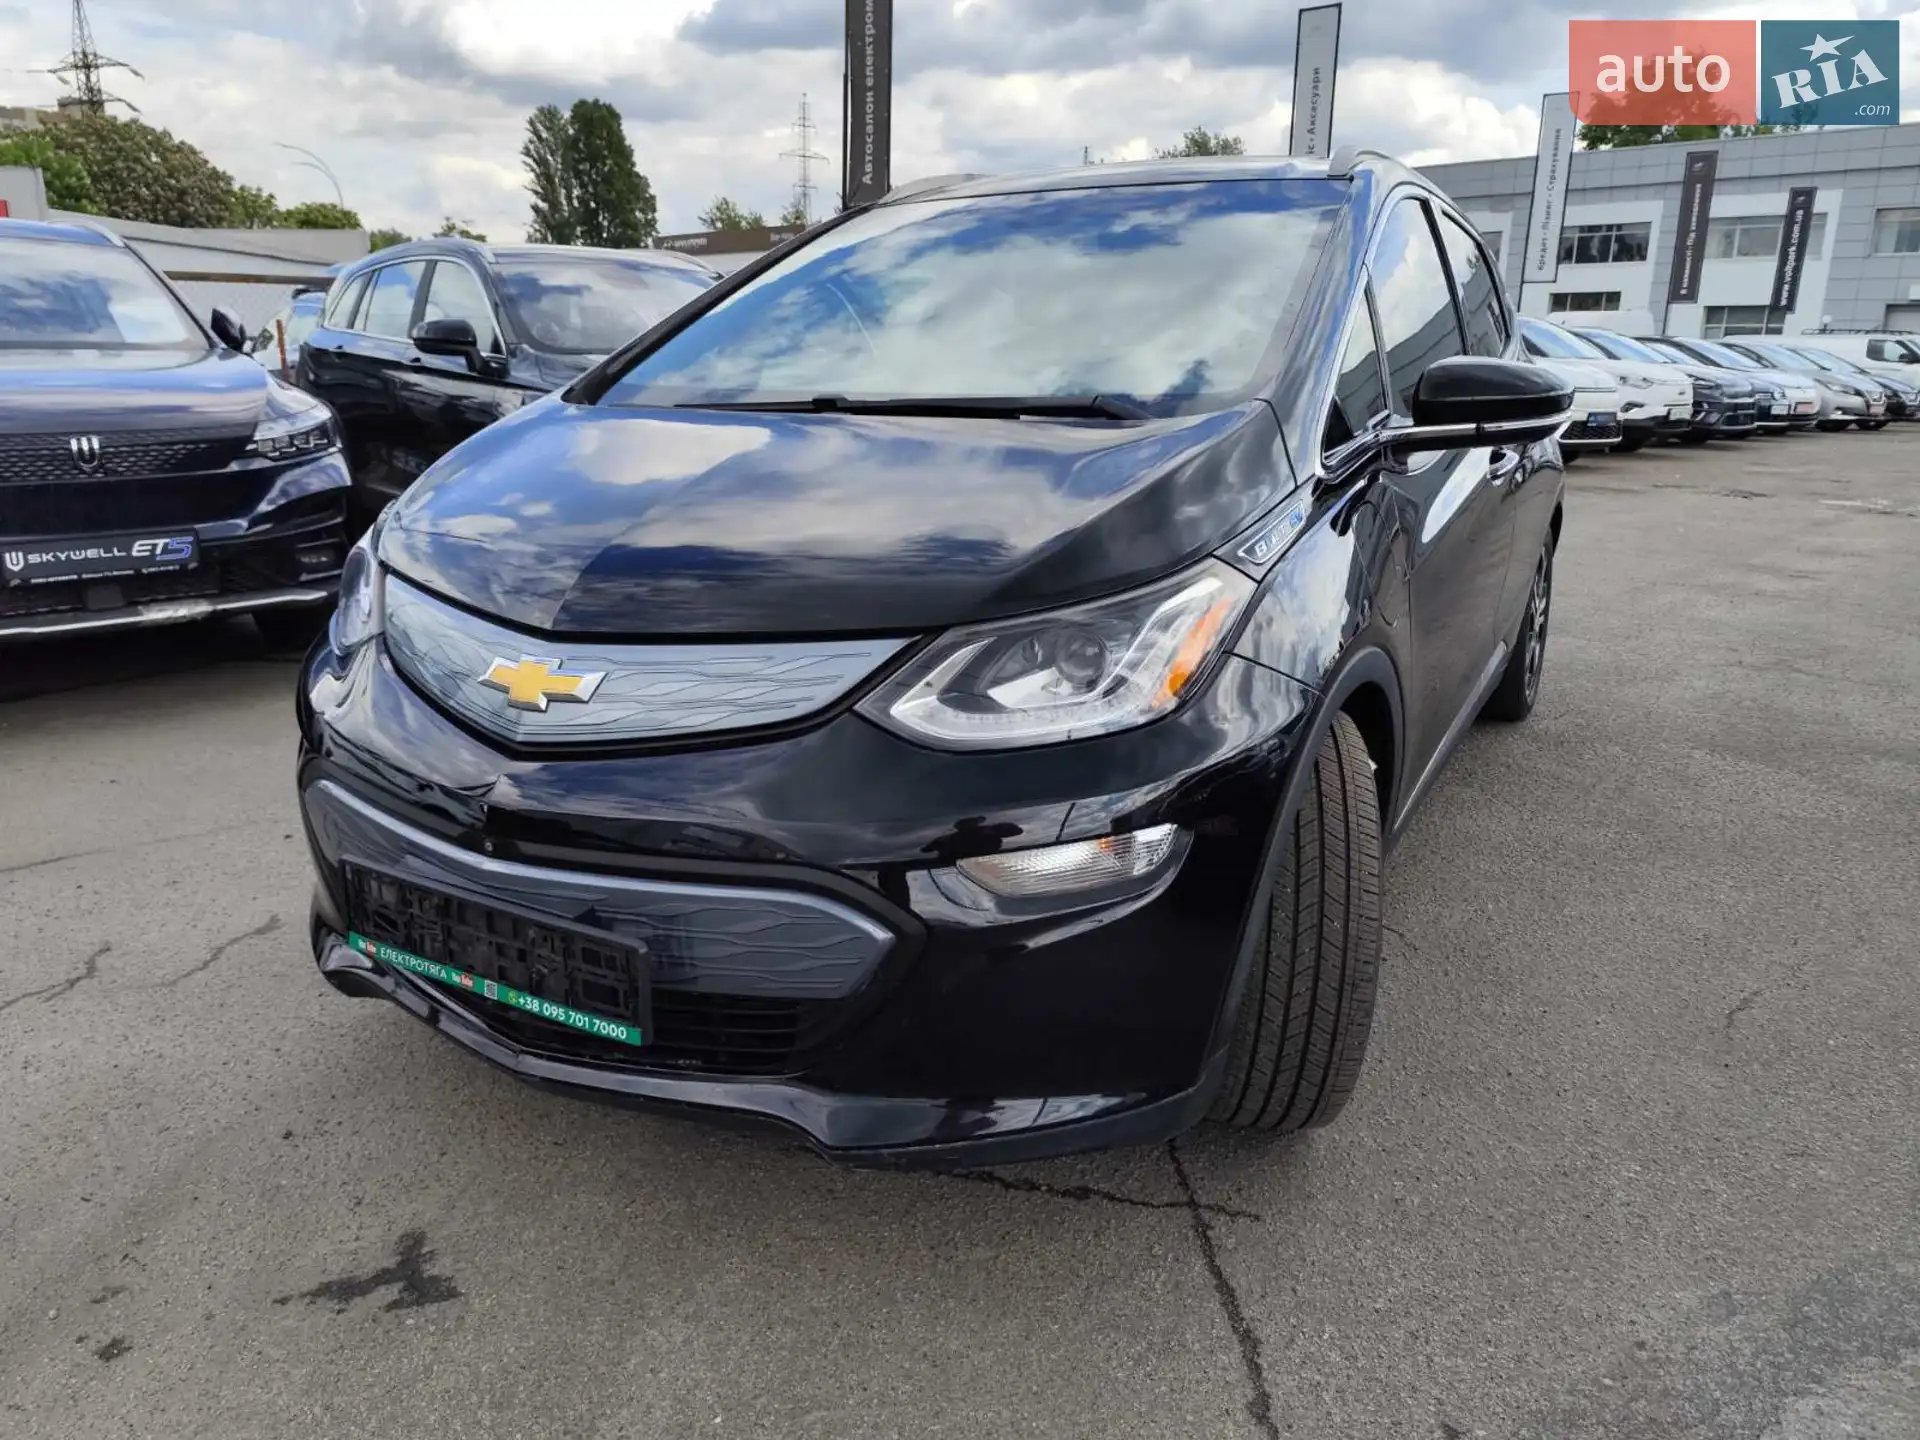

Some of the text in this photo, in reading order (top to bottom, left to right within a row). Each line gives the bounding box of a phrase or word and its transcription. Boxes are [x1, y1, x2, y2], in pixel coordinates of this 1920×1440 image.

[1307, 67, 1321, 134] Аксесуари
[862, 91, 875, 184] Автосалон
[27, 536, 194, 564] SKYWELL ET5
[380, 947, 447, 979] ЕЛЕКТРОТЯГА
[518, 995, 627, 1039] +38 095 701 7000
